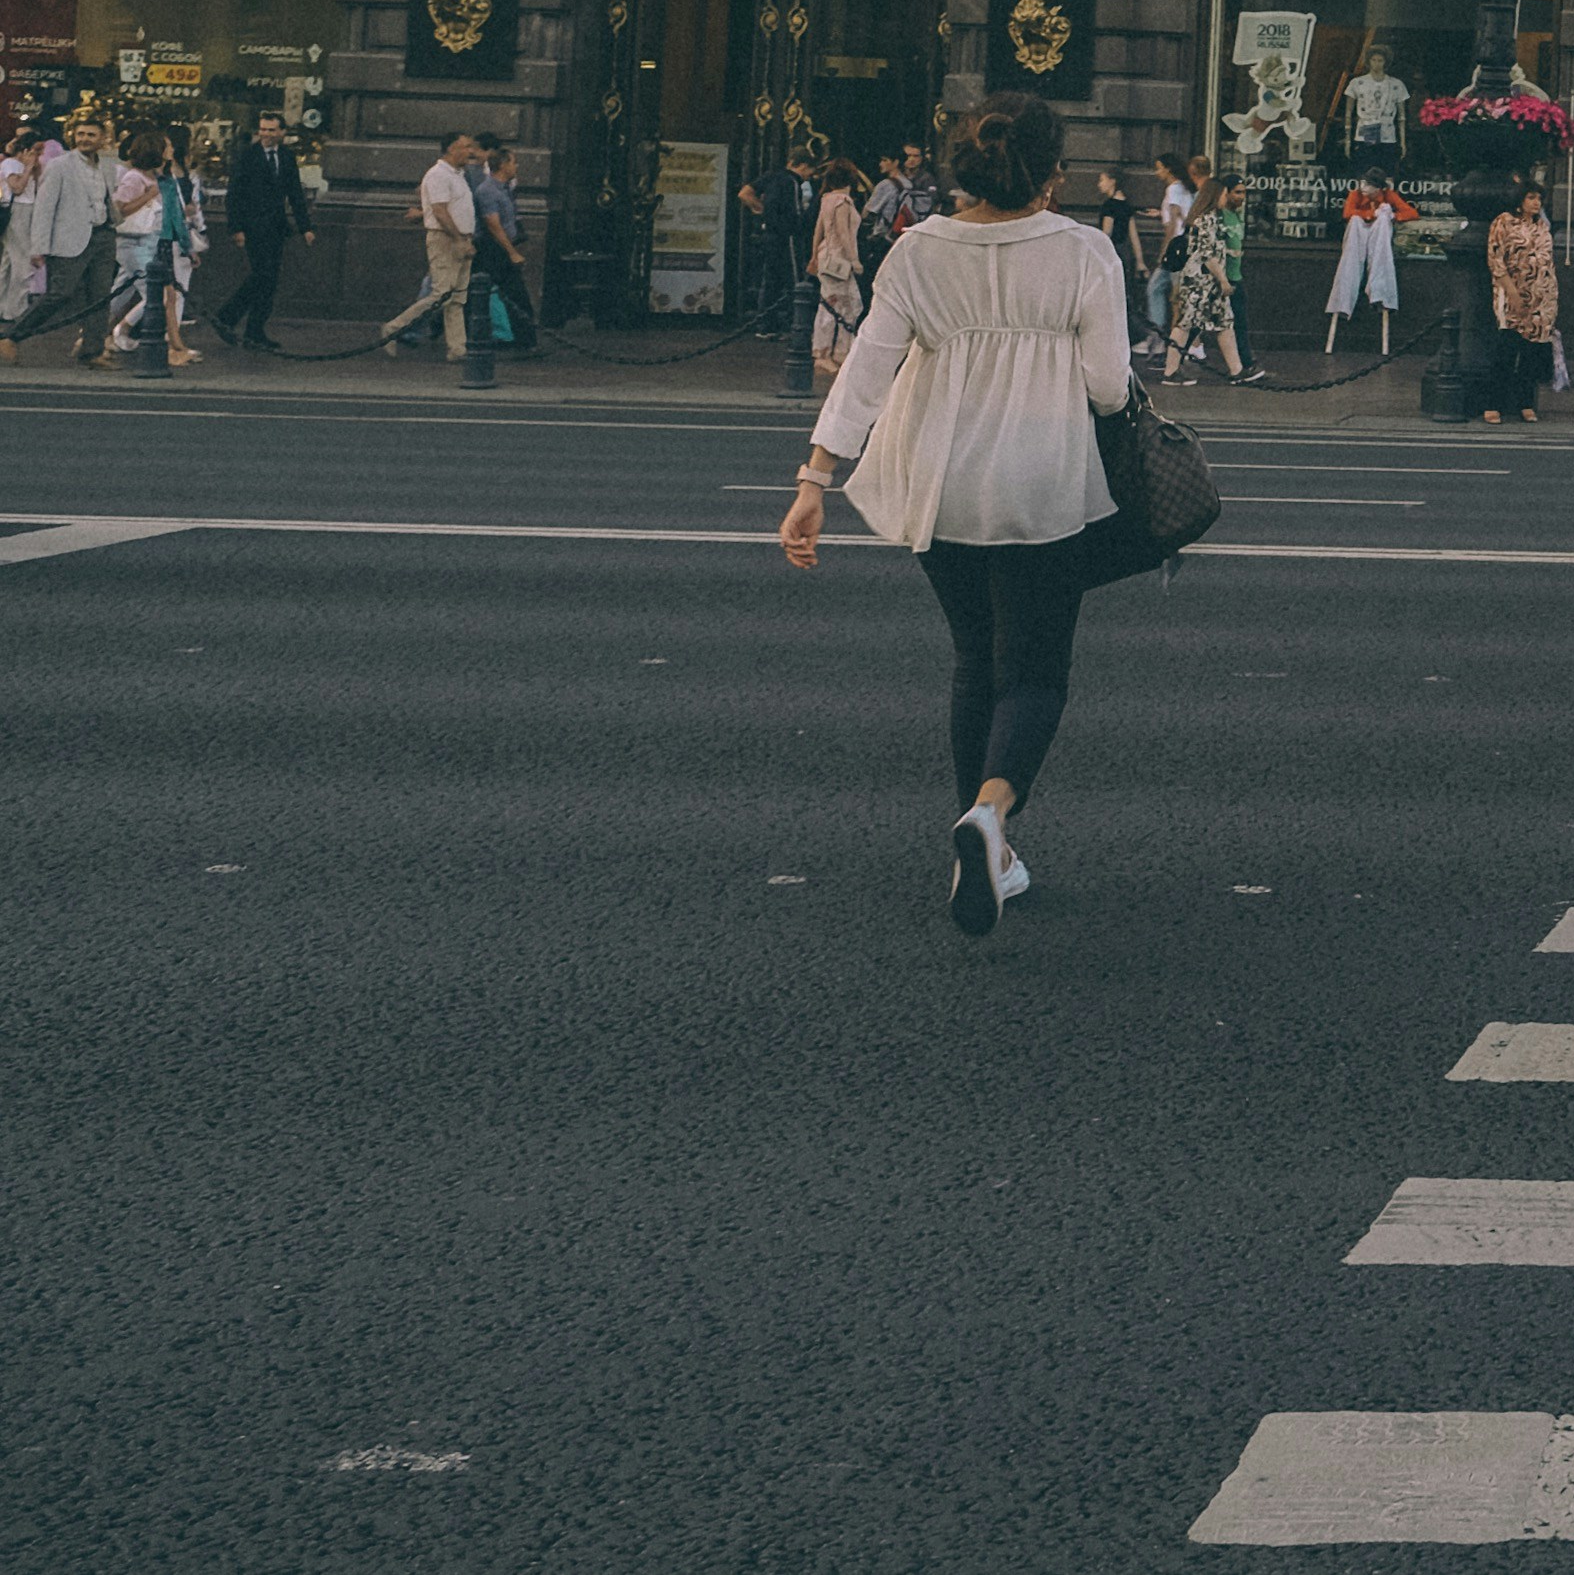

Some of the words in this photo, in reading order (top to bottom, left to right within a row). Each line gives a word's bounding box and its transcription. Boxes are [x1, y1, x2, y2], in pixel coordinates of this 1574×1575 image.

[1257, 23, 1291, 37] 2018
[151, 40, 184, 53] КОФЕ
[1246, 175, 1284, 191] 2018
[1399, 180, 1436, 195] CUP
